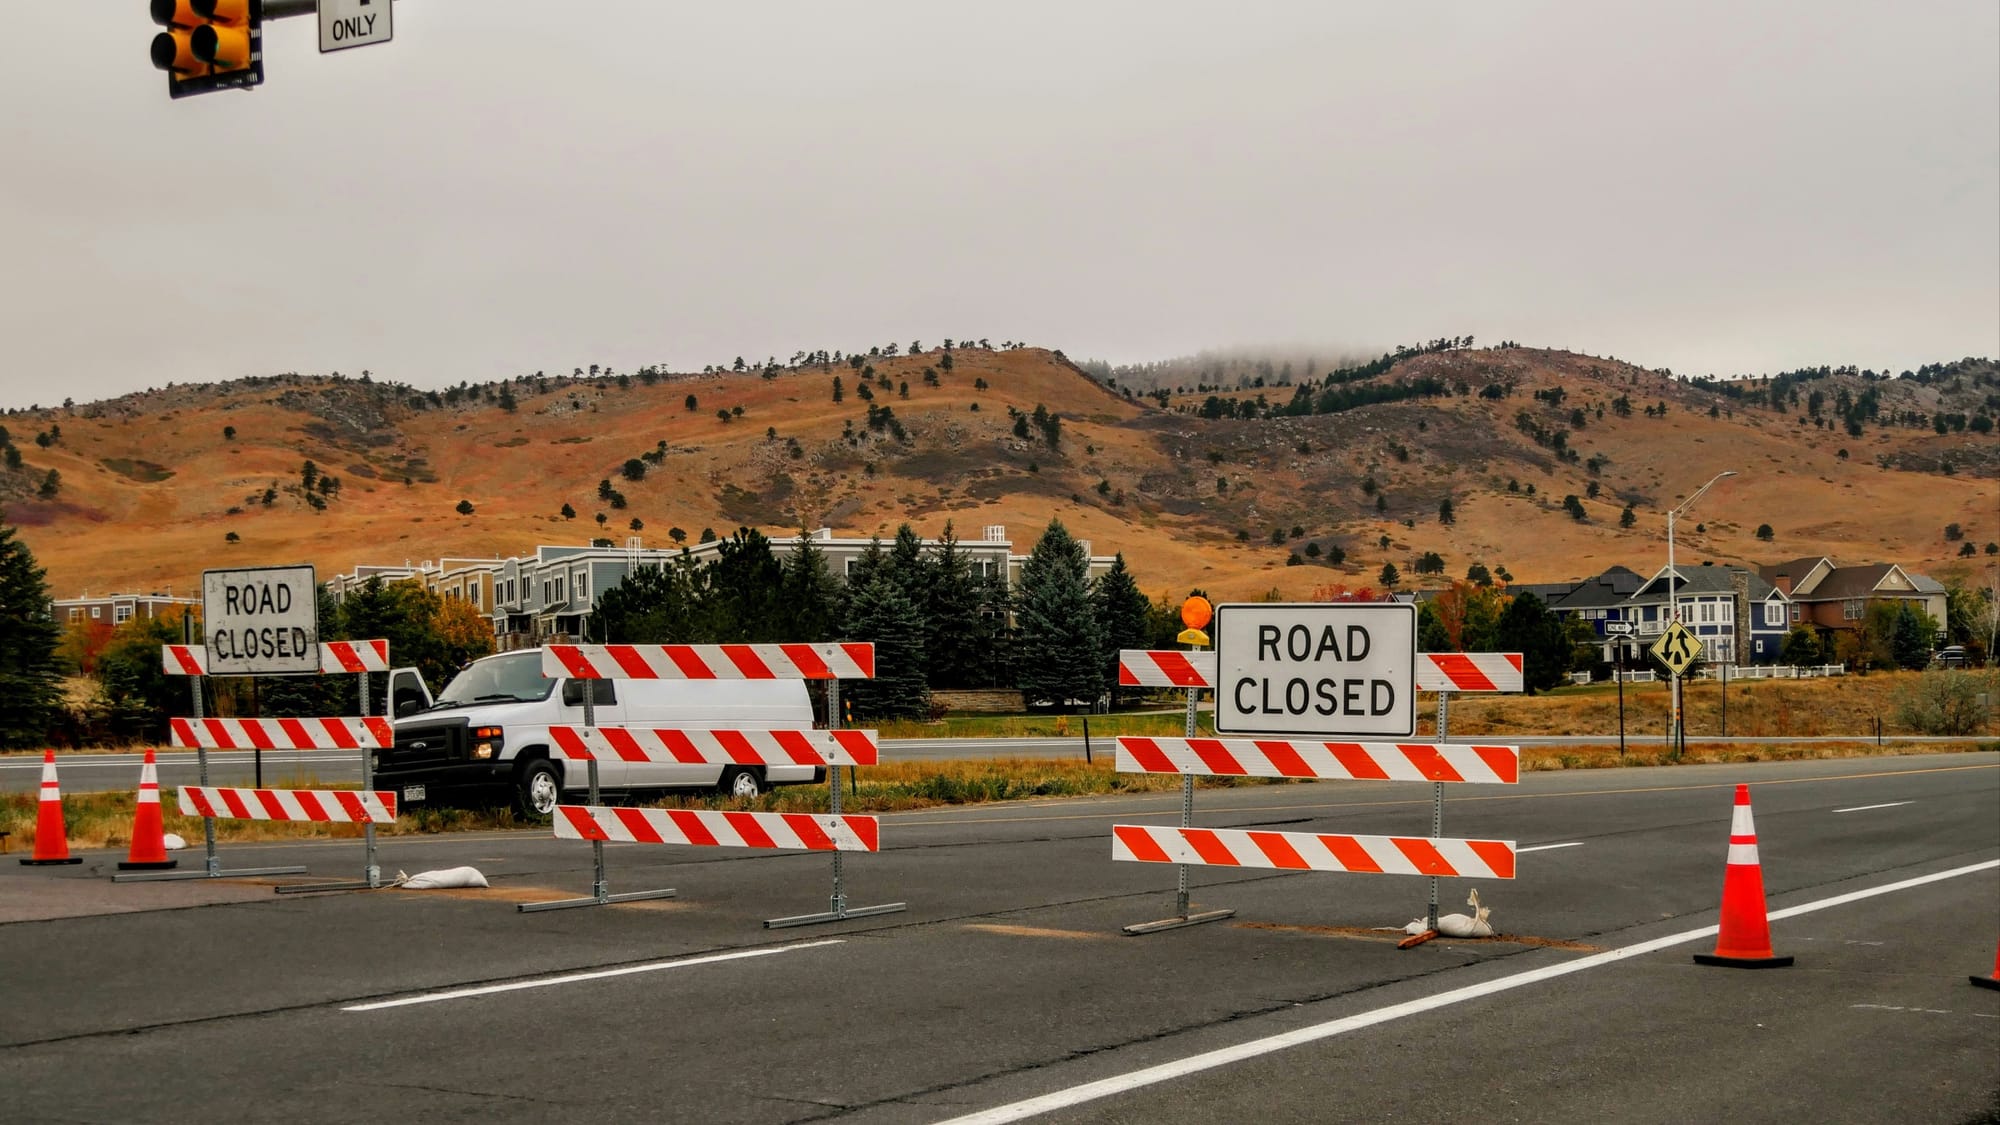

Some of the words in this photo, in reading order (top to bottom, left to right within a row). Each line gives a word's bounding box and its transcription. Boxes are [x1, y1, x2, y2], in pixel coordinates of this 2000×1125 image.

[332, 13, 376, 41] ONLY
[226, 583, 291, 616] ROAD
[215, 627, 307, 660] CLOSED
[1258, 624, 1370, 662] ROAD
[1234, 677, 1395, 716] CLOSED
